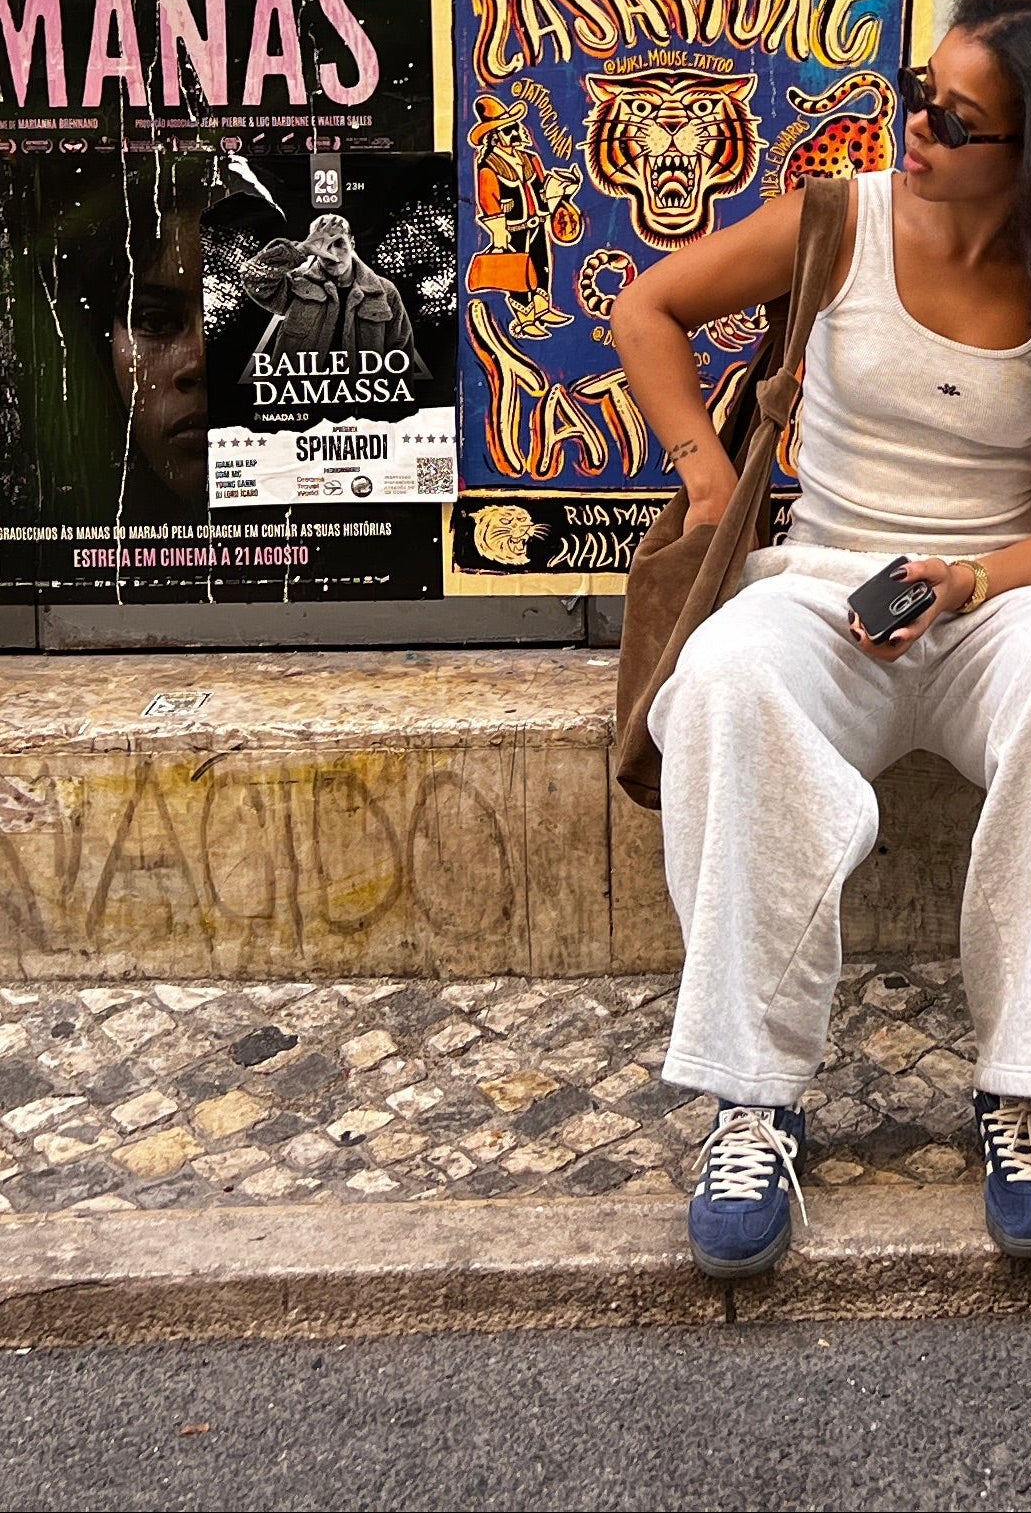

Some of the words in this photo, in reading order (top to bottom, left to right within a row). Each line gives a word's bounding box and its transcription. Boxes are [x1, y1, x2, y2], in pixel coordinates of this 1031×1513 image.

[314, 170, 338, 193] 29
[346, 182, 365, 191] 23H
[252, 352, 350, 377] BAILE
[359, 350, 409, 374] DO
[253, 380, 414, 405] DAMASSA
[296, 434, 387, 461] SPINARDI
[567, 505, 609, 525] RUA
[76, 526, 111, 540] MANAS
[129, 523, 168, 539] MARAJÓ
[172, 525, 193, 538] PELA
[197, 525, 242, 538] CORAGEM
[245, 524, 258, 537] EM
[261, 523, 298, 537] CONTAR
[343, 521, 391, 536] HISTÓRIAS
[74, 549, 131, 567] ESTREIA
[134, 548, 158, 566] EM
[160, 547, 217, 566] CINEMA
[221, 547, 231, 565] A
[234, 547, 250, 565] 21
[254, 546, 308, 565] AGOSTO
